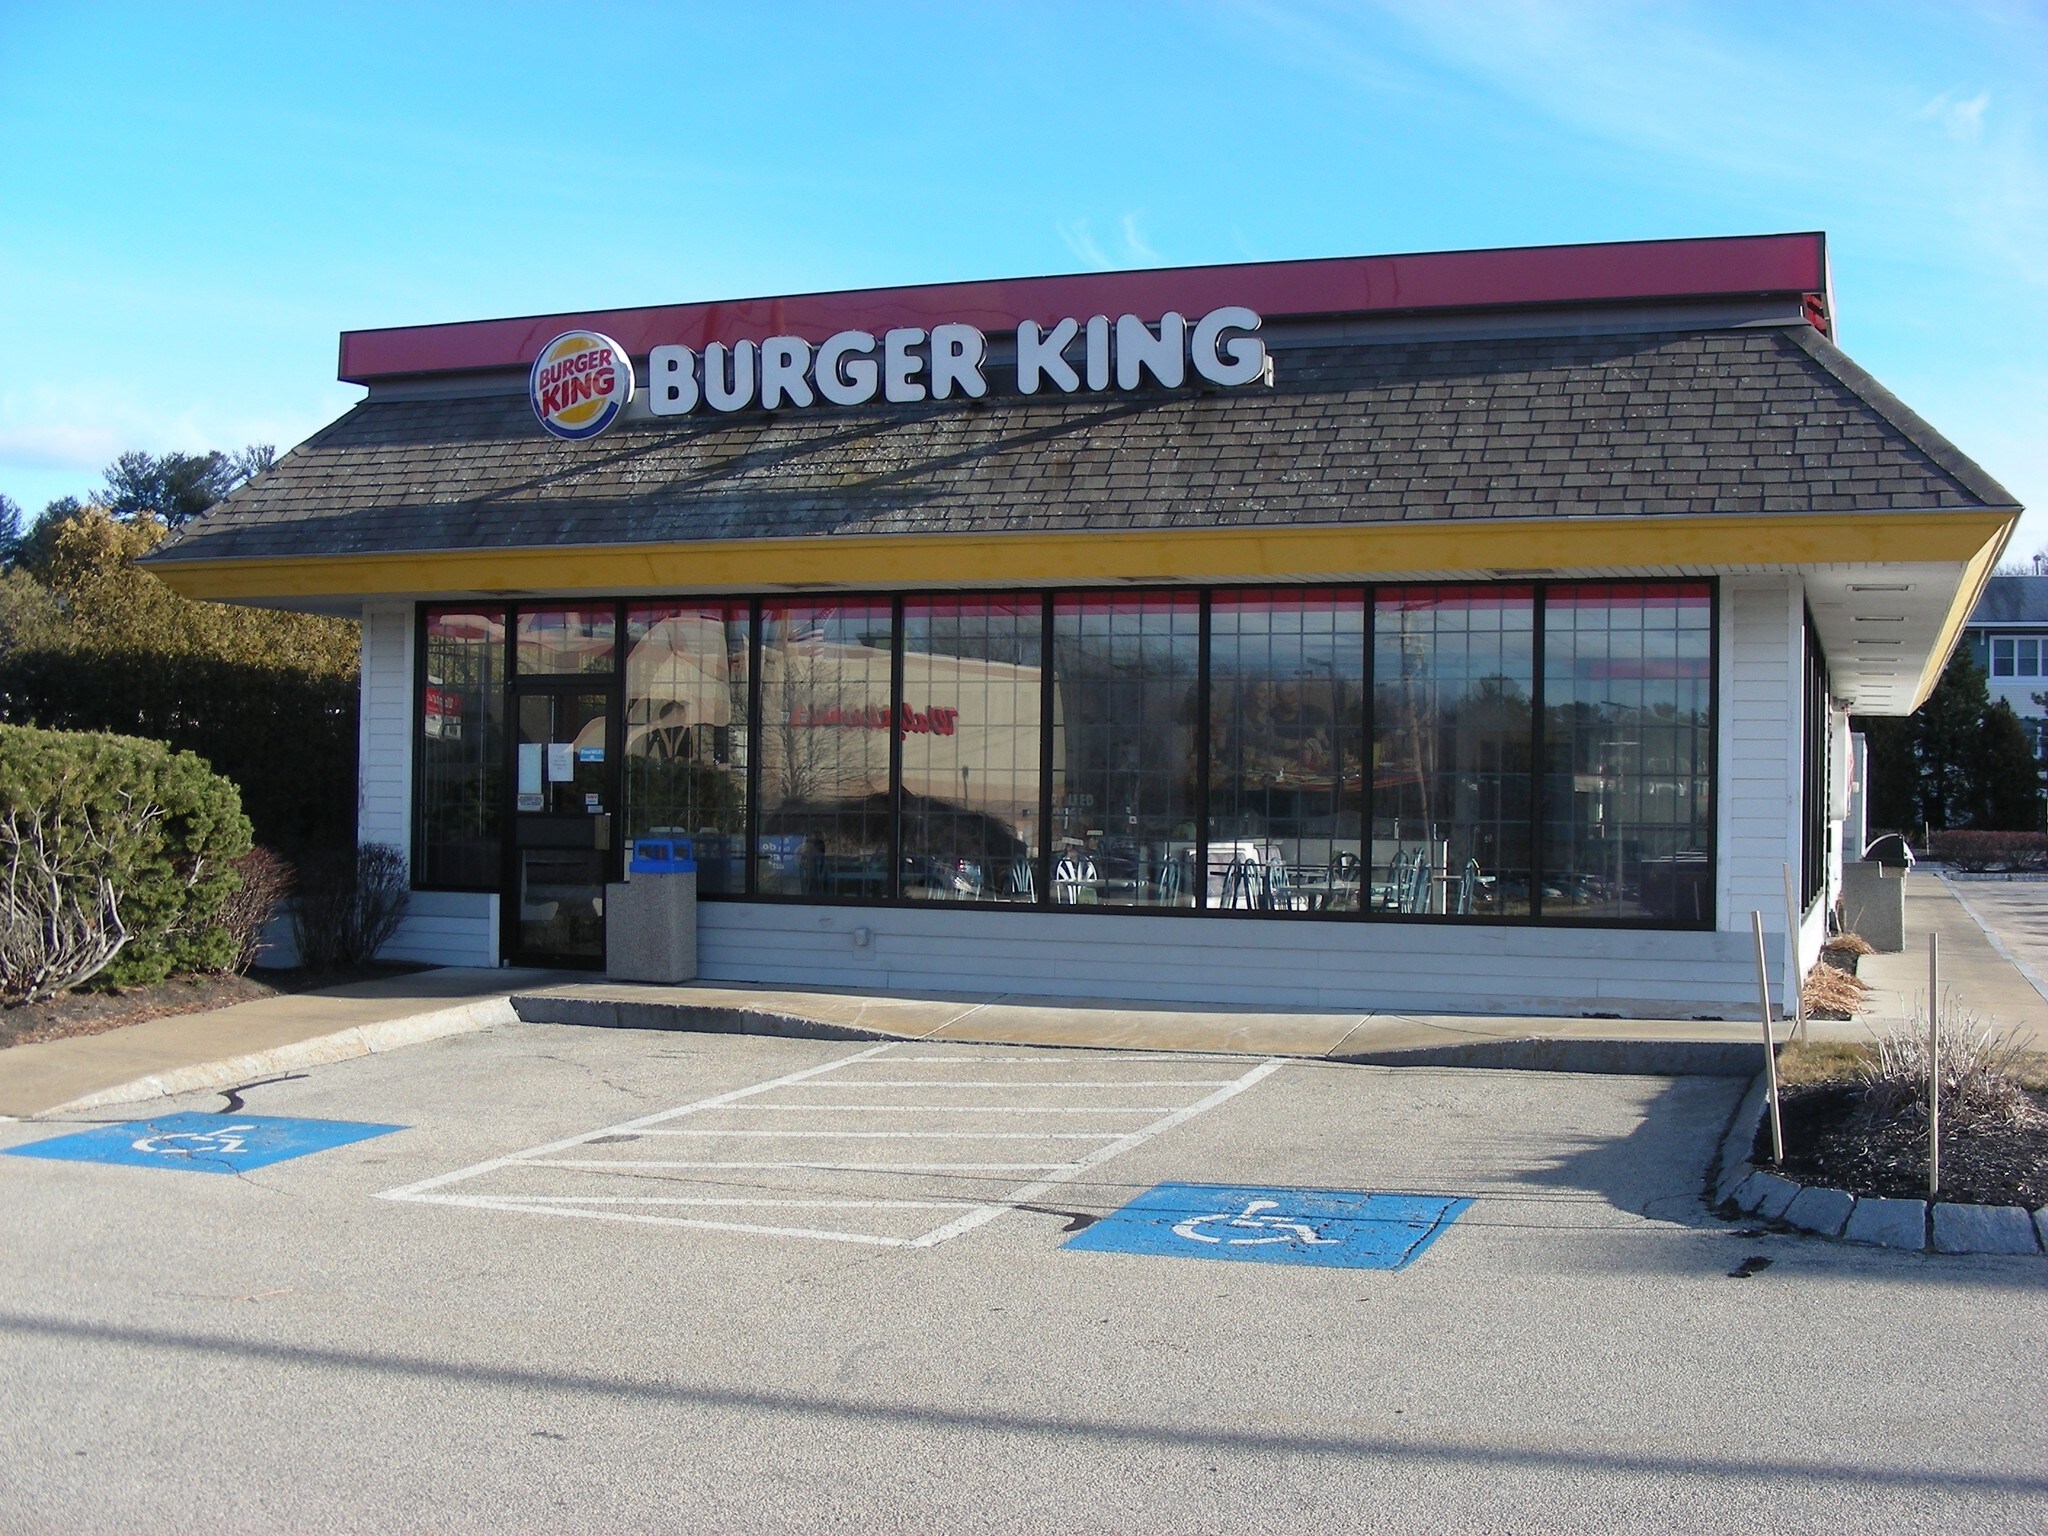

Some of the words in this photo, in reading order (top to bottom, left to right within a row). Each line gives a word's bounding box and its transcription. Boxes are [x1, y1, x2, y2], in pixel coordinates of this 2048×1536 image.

[540, 348, 612, 390] BURGER
[649, 323, 988, 417] BURGER
[1017, 306, 1265, 395] KING
[542, 367, 615, 418] KING
